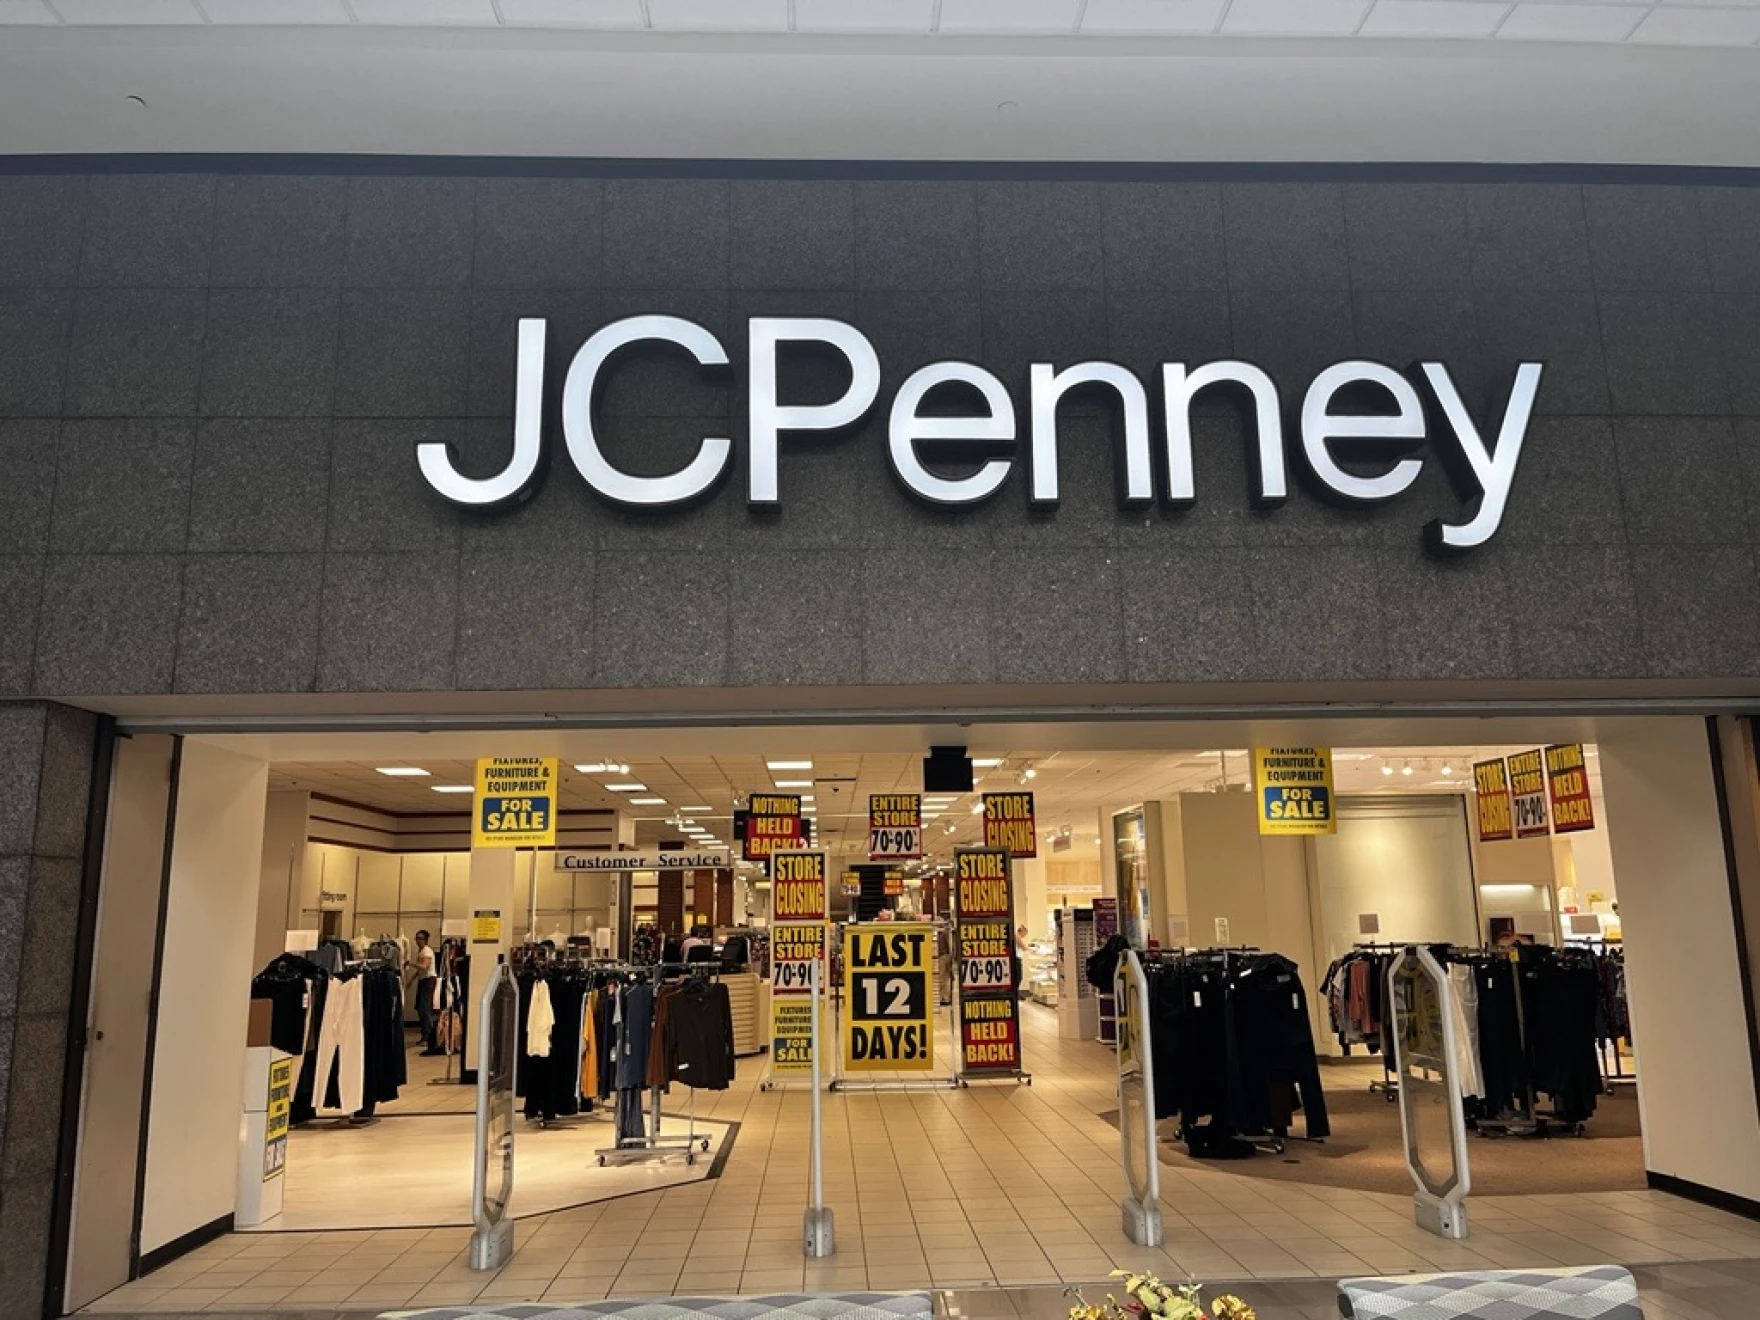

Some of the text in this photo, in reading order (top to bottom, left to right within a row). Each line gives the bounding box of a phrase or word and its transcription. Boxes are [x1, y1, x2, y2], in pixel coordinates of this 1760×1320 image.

[415, 314, 1544, 548] JCPenney
[1263, 757, 1326, 768] FURNITURE &
[485, 767, 551, 779] FURNITURE &
[1267, 771, 1324, 782] EQUIPMENT
[487, 780, 547, 792] EQUIPMENT
[1512, 771, 1543, 794] STORE
[1553, 771, 1583, 798] HELD
[872, 796, 919, 810] ENTIRE
[1281, 788, 1312, 800] FOR
[501, 799, 532, 812] FOR
[752, 797, 799, 814] NOTHING
[986, 796, 1031, 819] STORE
[1269, 800, 1325, 818] SALE
[1553, 799, 1591, 825] BACK!
[487, 811, 544, 830] SALE
[756, 818, 793, 835] HELD
[874, 811, 917, 826] STORE
[986, 820, 1034, 852] CLOSING
[563, 854, 722, 869] Customer Service
[776, 855, 822, 880] STORE
[960, 854, 1005, 878] STORE
[776, 882, 824, 915] CLOSING
[960, 880, 1008, 912] CLOSING
[774, 927, 823, 943] ENTIRE
[960, 924, 1008, 940] ENTIRE
[776, 943, 823, 959] STORE
[852, 933, 925, 967] LAST
[962, 940, 1007, 957] STORE
[862, 978, 911, 1015] 12
[965, 1001, 1012, 1019] NOTHING
[970, 1021, 1008, 1040] HELD
[786, 1039, 808, 1048] FOR
[852, 1024, 927, 1060] DAYS!
[966, 1043, 1015, 1062] BACK!
